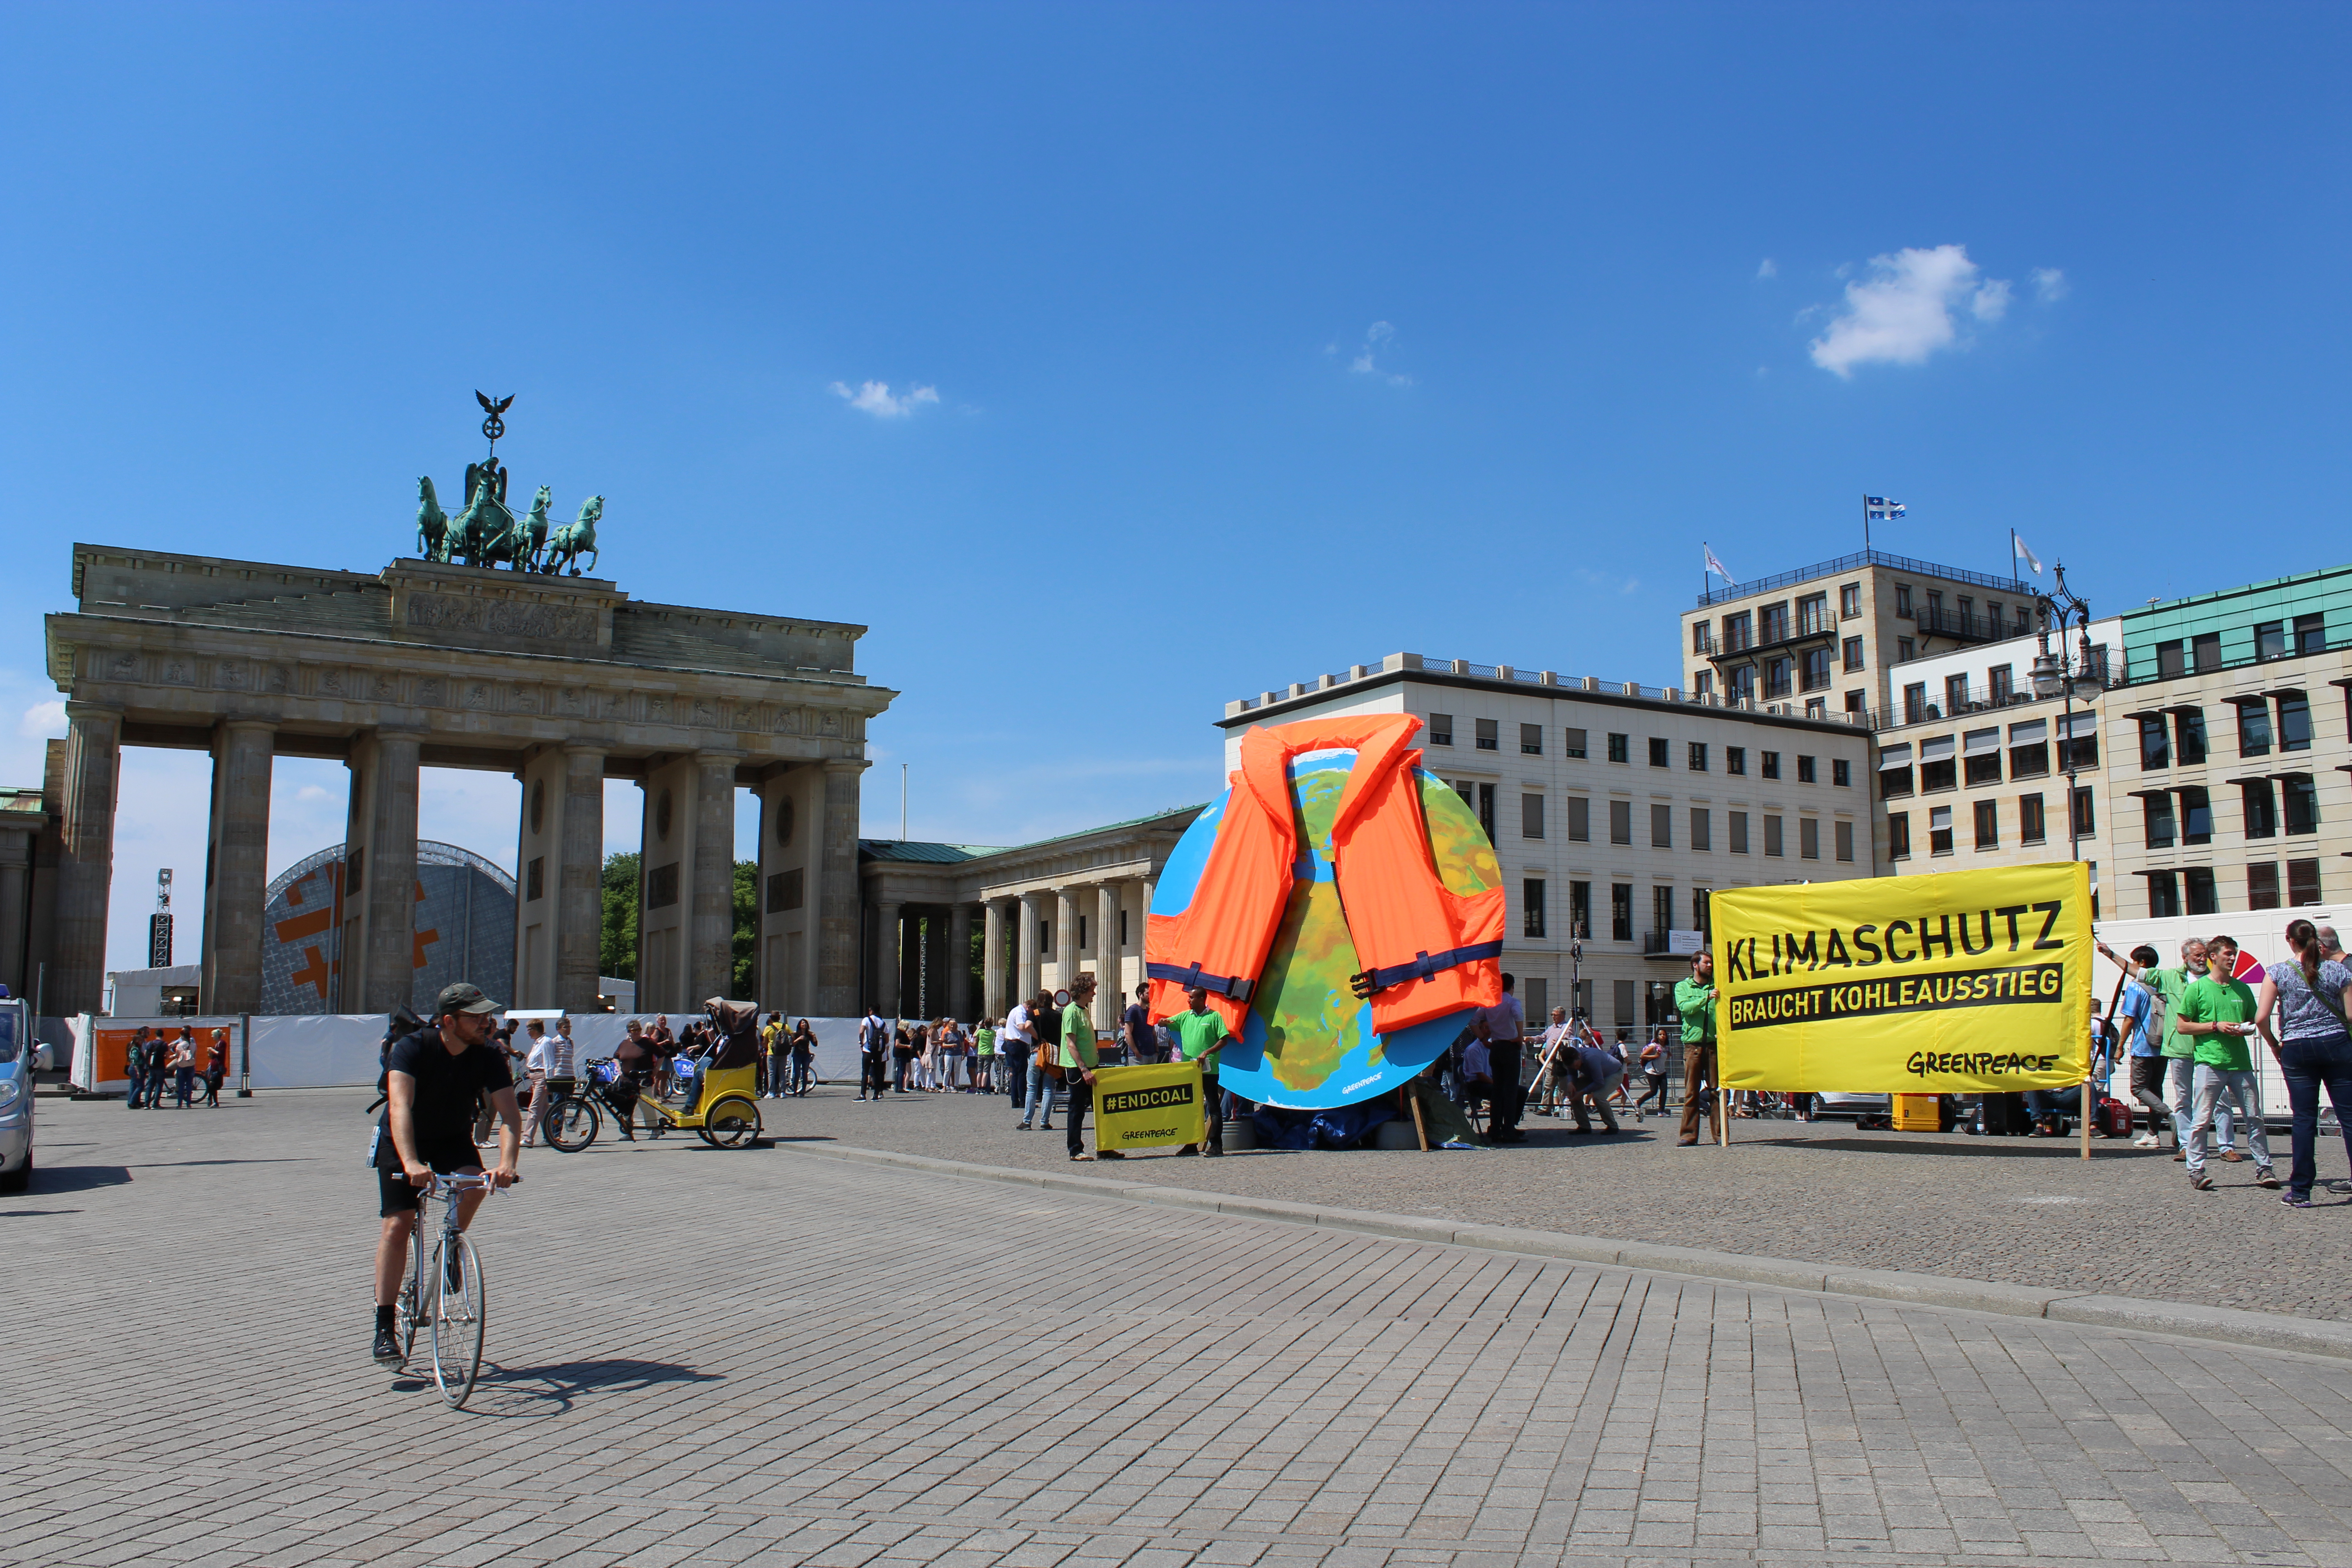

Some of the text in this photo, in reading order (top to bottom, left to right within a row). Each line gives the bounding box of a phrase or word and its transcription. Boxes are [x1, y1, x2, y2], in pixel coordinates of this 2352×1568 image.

[1727, 900, 2063, 983] KLIMASCHUTZ
[1732, 969, 2058, 1023] BRAUCHT KOHLEAUSSTIEG
[1906, 1051, 2059, 1078] GREENPEACE
[1342, 1072, 1382, 1094] GREENPEACE
[1107, 1088, 1191, 1110] #ENDCOAL
[1122, 1128, 1178, 1140] GREENPEACE
